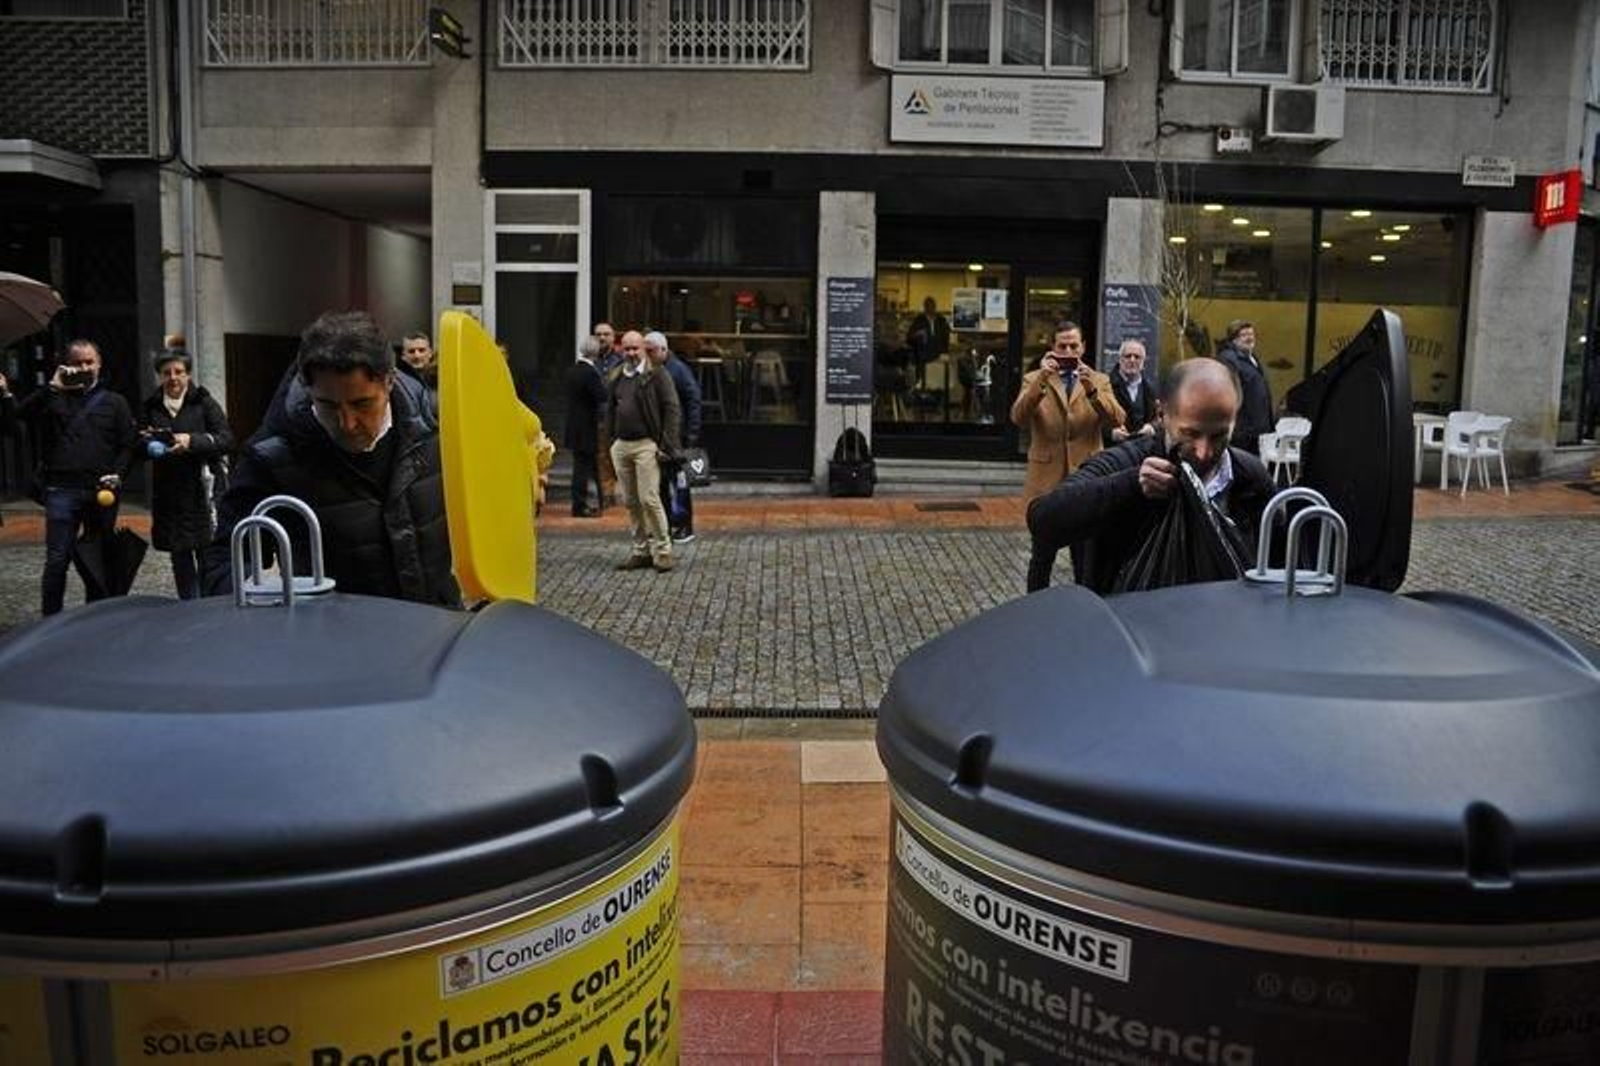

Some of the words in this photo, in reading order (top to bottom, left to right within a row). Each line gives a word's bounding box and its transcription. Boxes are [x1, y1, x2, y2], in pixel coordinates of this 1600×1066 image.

[933, 86, 979, 99] Gabinete
[486, 927, 576, 973] Concello
[581, 912, 600, 935] de
[602, 848, 672, 924] OURENSE
[953, 884, 971, 908] de
[973, 894, 1118, 970] OURENSE
[571, 958, 620, 1004] con
[940, 939, 989, 985] con
[142, 1024, 291, 1056] SOLGALEO
